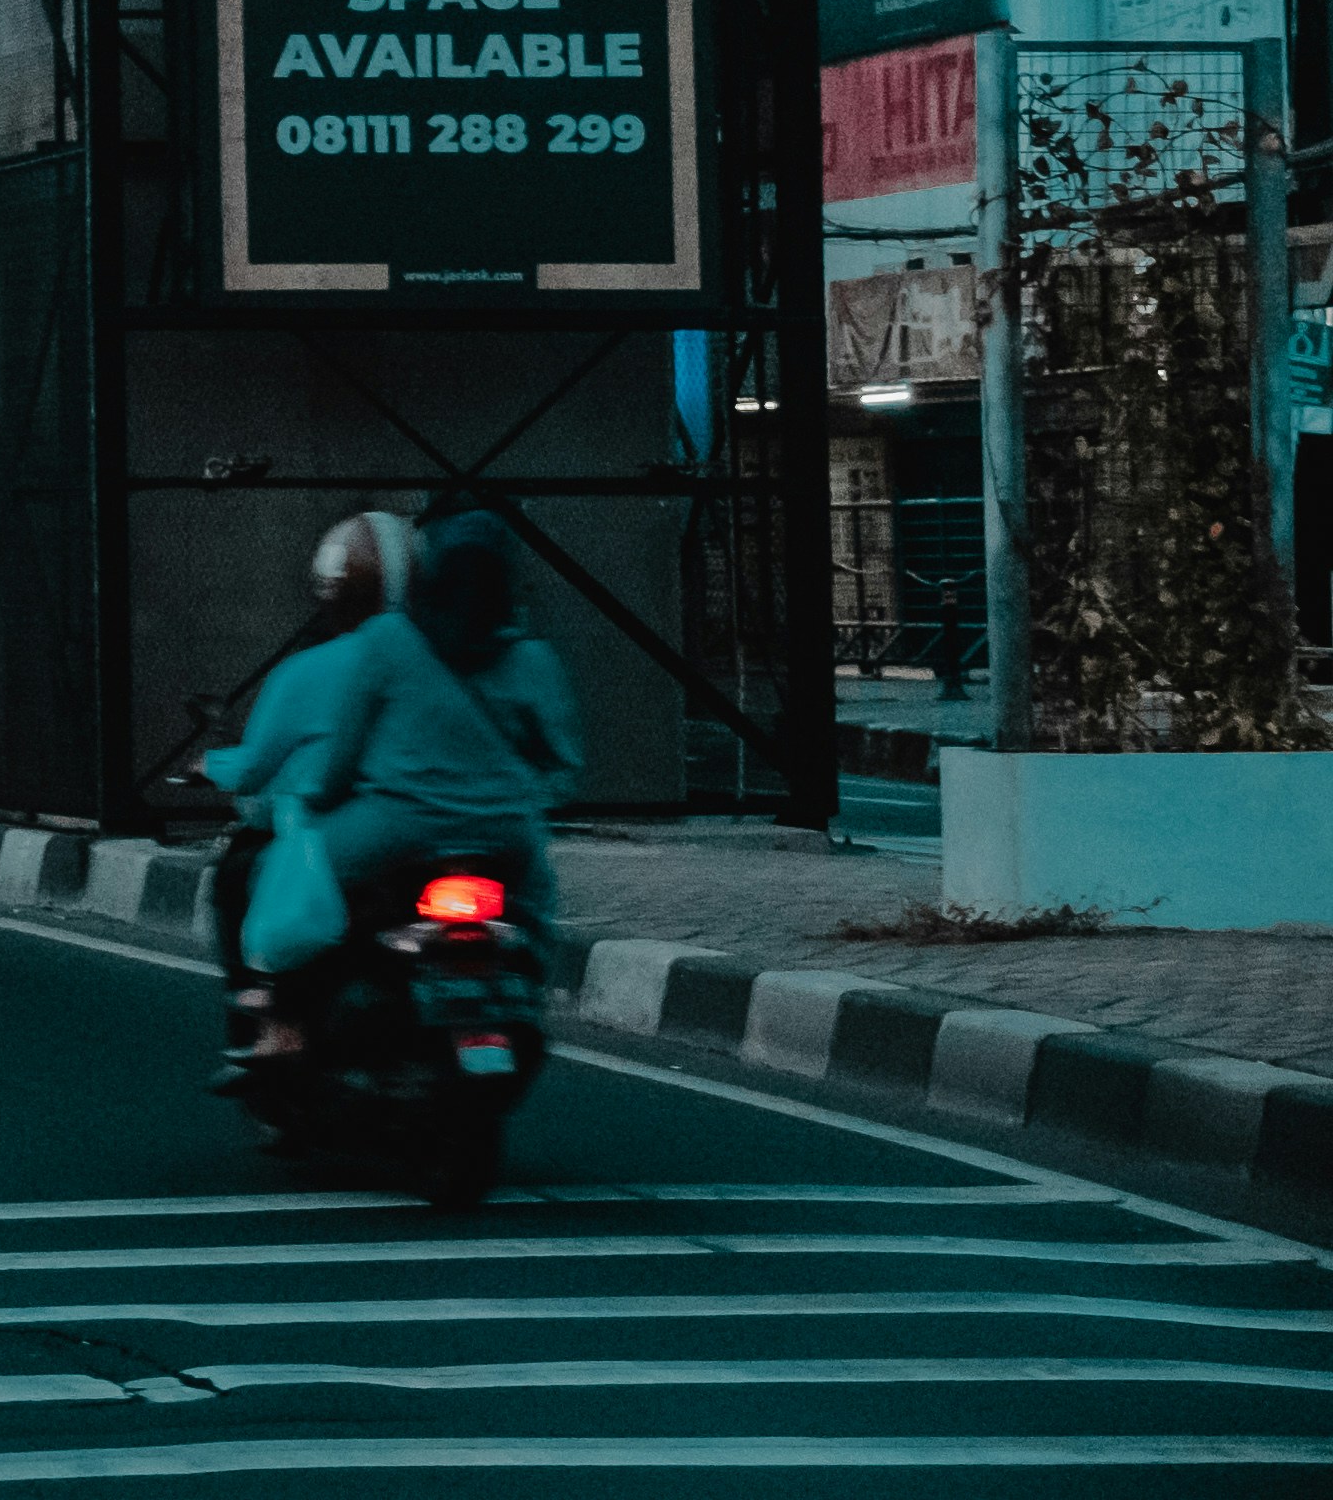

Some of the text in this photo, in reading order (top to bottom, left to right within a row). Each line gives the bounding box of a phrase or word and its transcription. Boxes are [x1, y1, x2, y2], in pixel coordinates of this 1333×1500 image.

[273, 33, 643, 78] AVAILABLE
[276, 113, 646, 155] 08111 288 299
